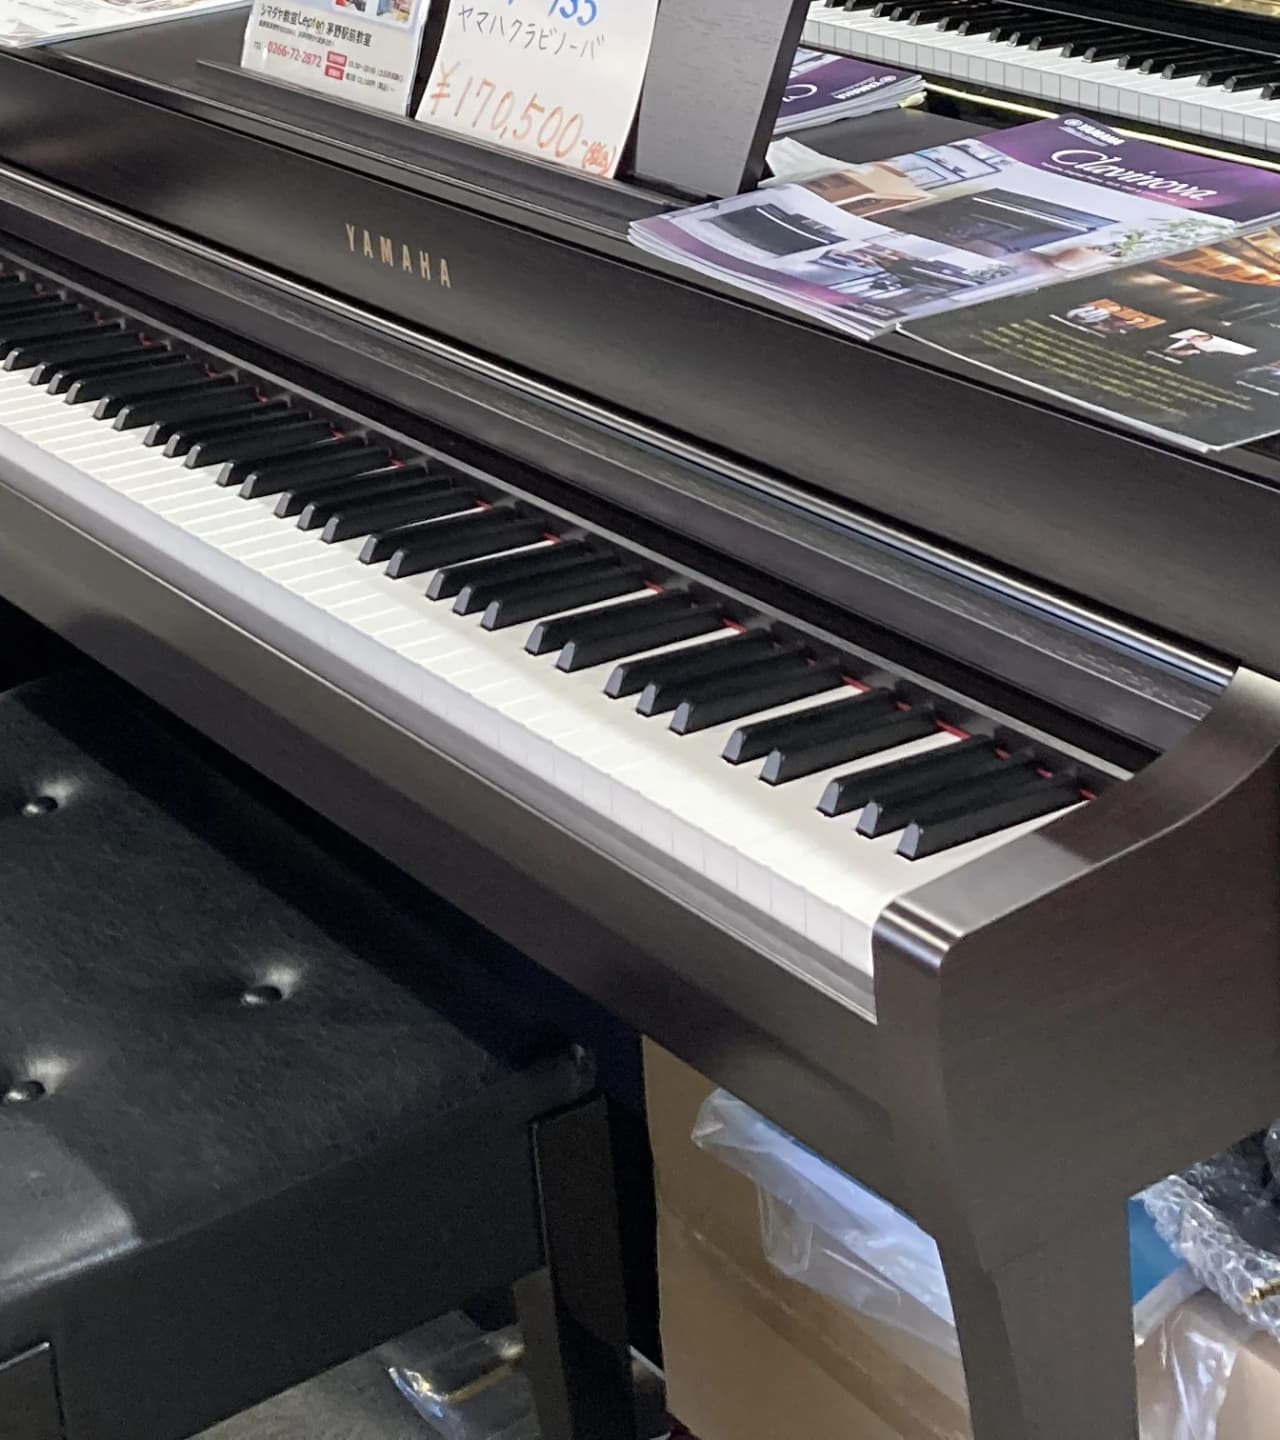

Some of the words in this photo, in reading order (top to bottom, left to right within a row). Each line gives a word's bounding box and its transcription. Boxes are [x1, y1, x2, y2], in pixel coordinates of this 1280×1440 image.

[458, 4, 605, 60] ヤマハクラビノーバ
[1077, 122, 1125, 146] YAMAHA
[1051, 149, 1217, 201] Clavinova
[345, 223, 451, 288] YAMAHA
